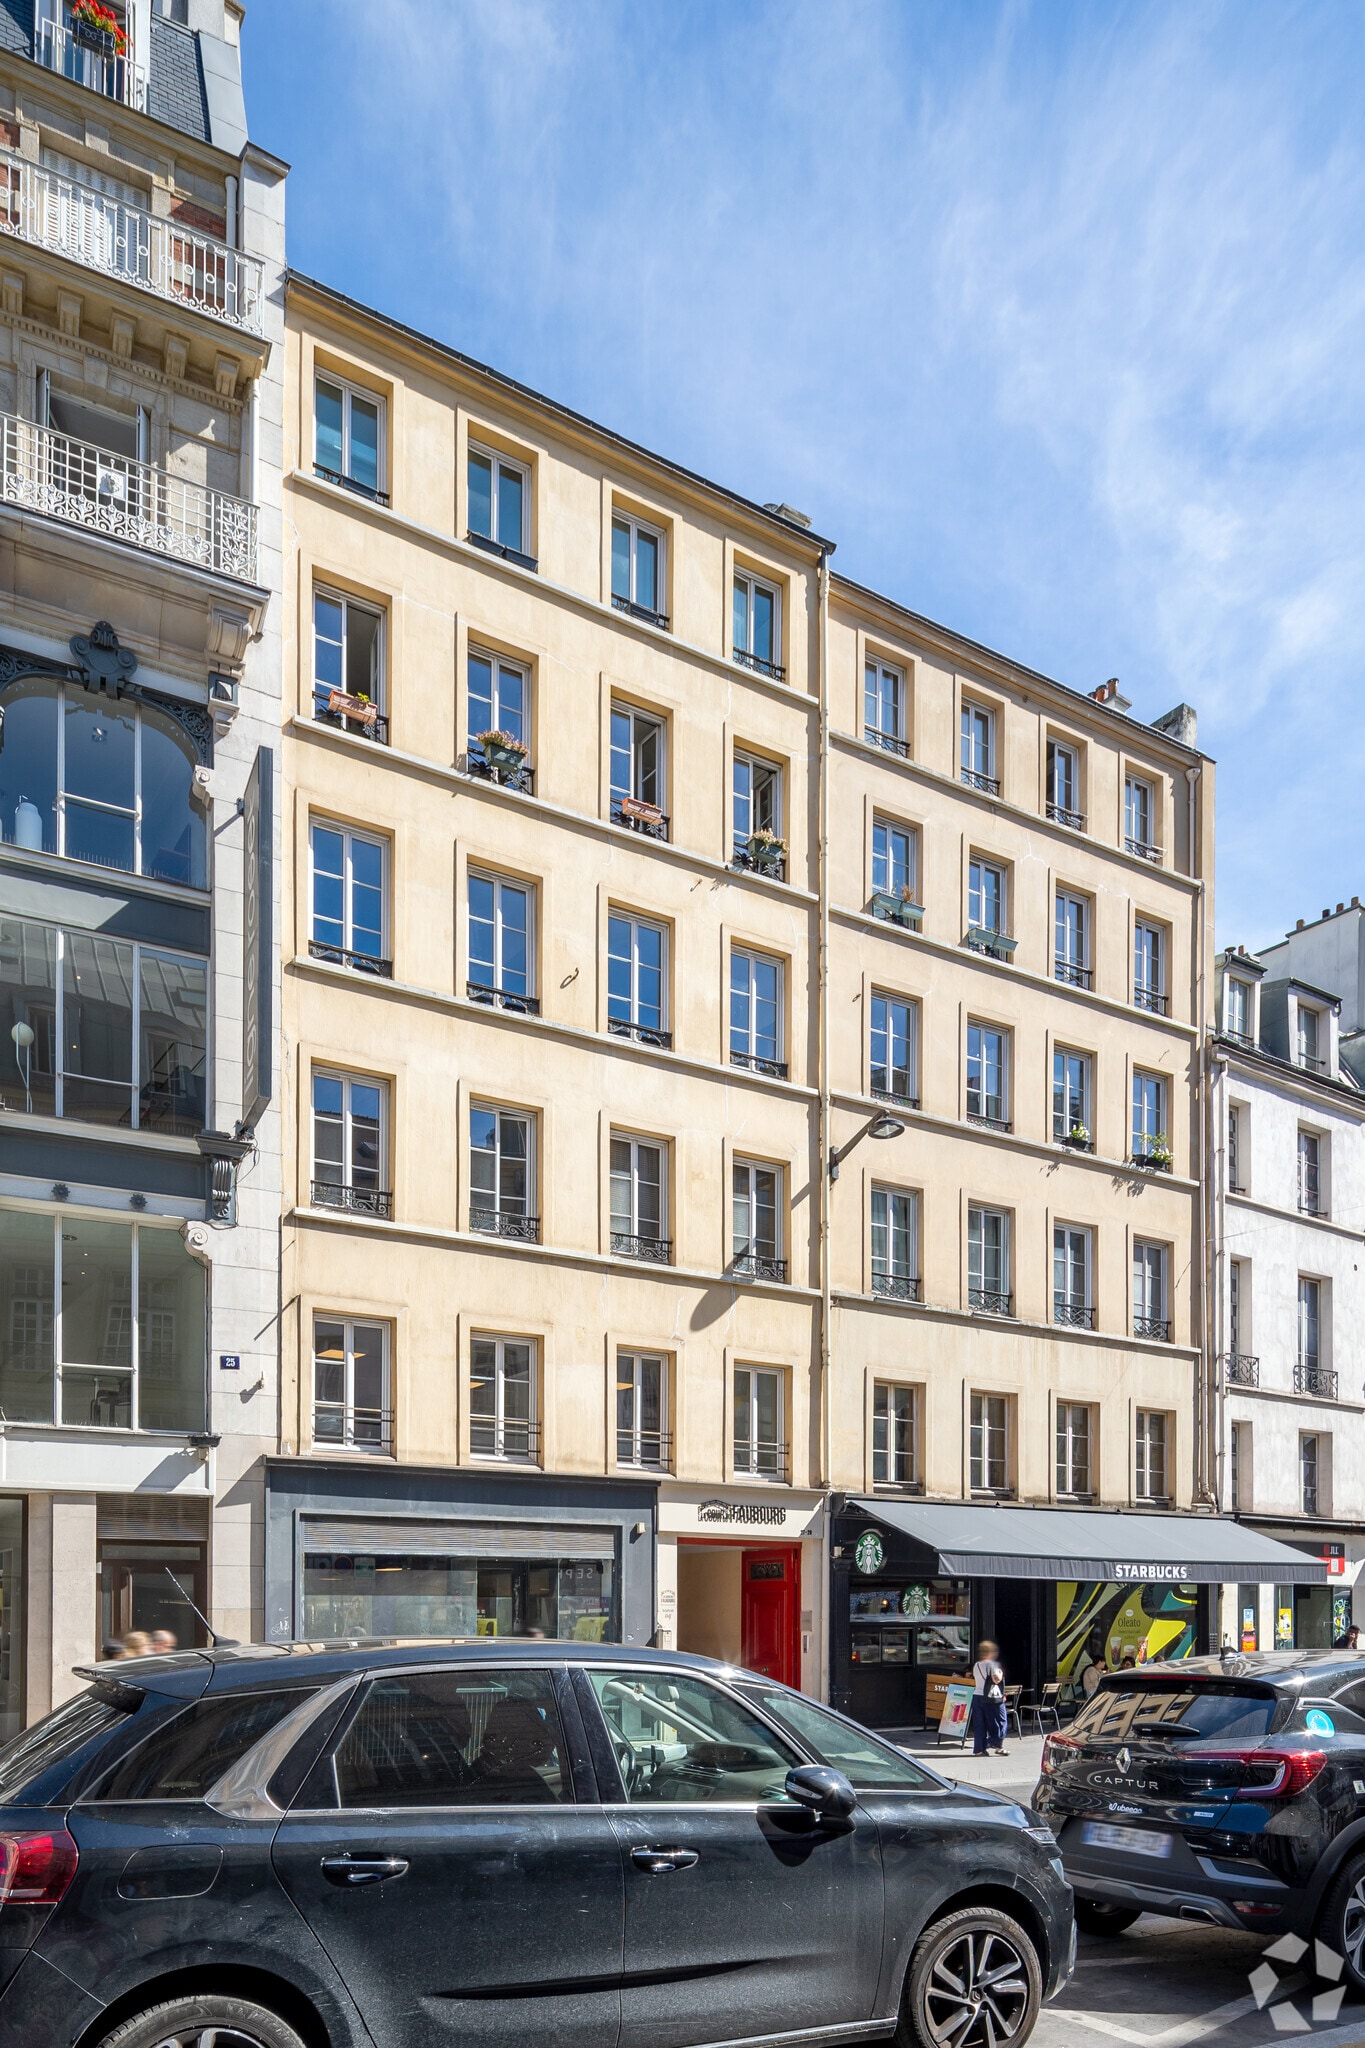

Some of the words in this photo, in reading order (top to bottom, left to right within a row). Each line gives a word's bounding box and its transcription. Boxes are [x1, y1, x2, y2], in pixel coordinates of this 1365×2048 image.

[247, 788, 256, 949] roset
[244, 953, 257, 1094] ligne
[225, 1357, 236, 1367] 25
[731, 1504, 786, 1525] FAUBOURG
[1115, 1564, 1187, 1579] STARBUCKS
[1118, 1617, 1141, 1627] Oleato
[1094, 1775, 1159, 1790] CAPTUR
